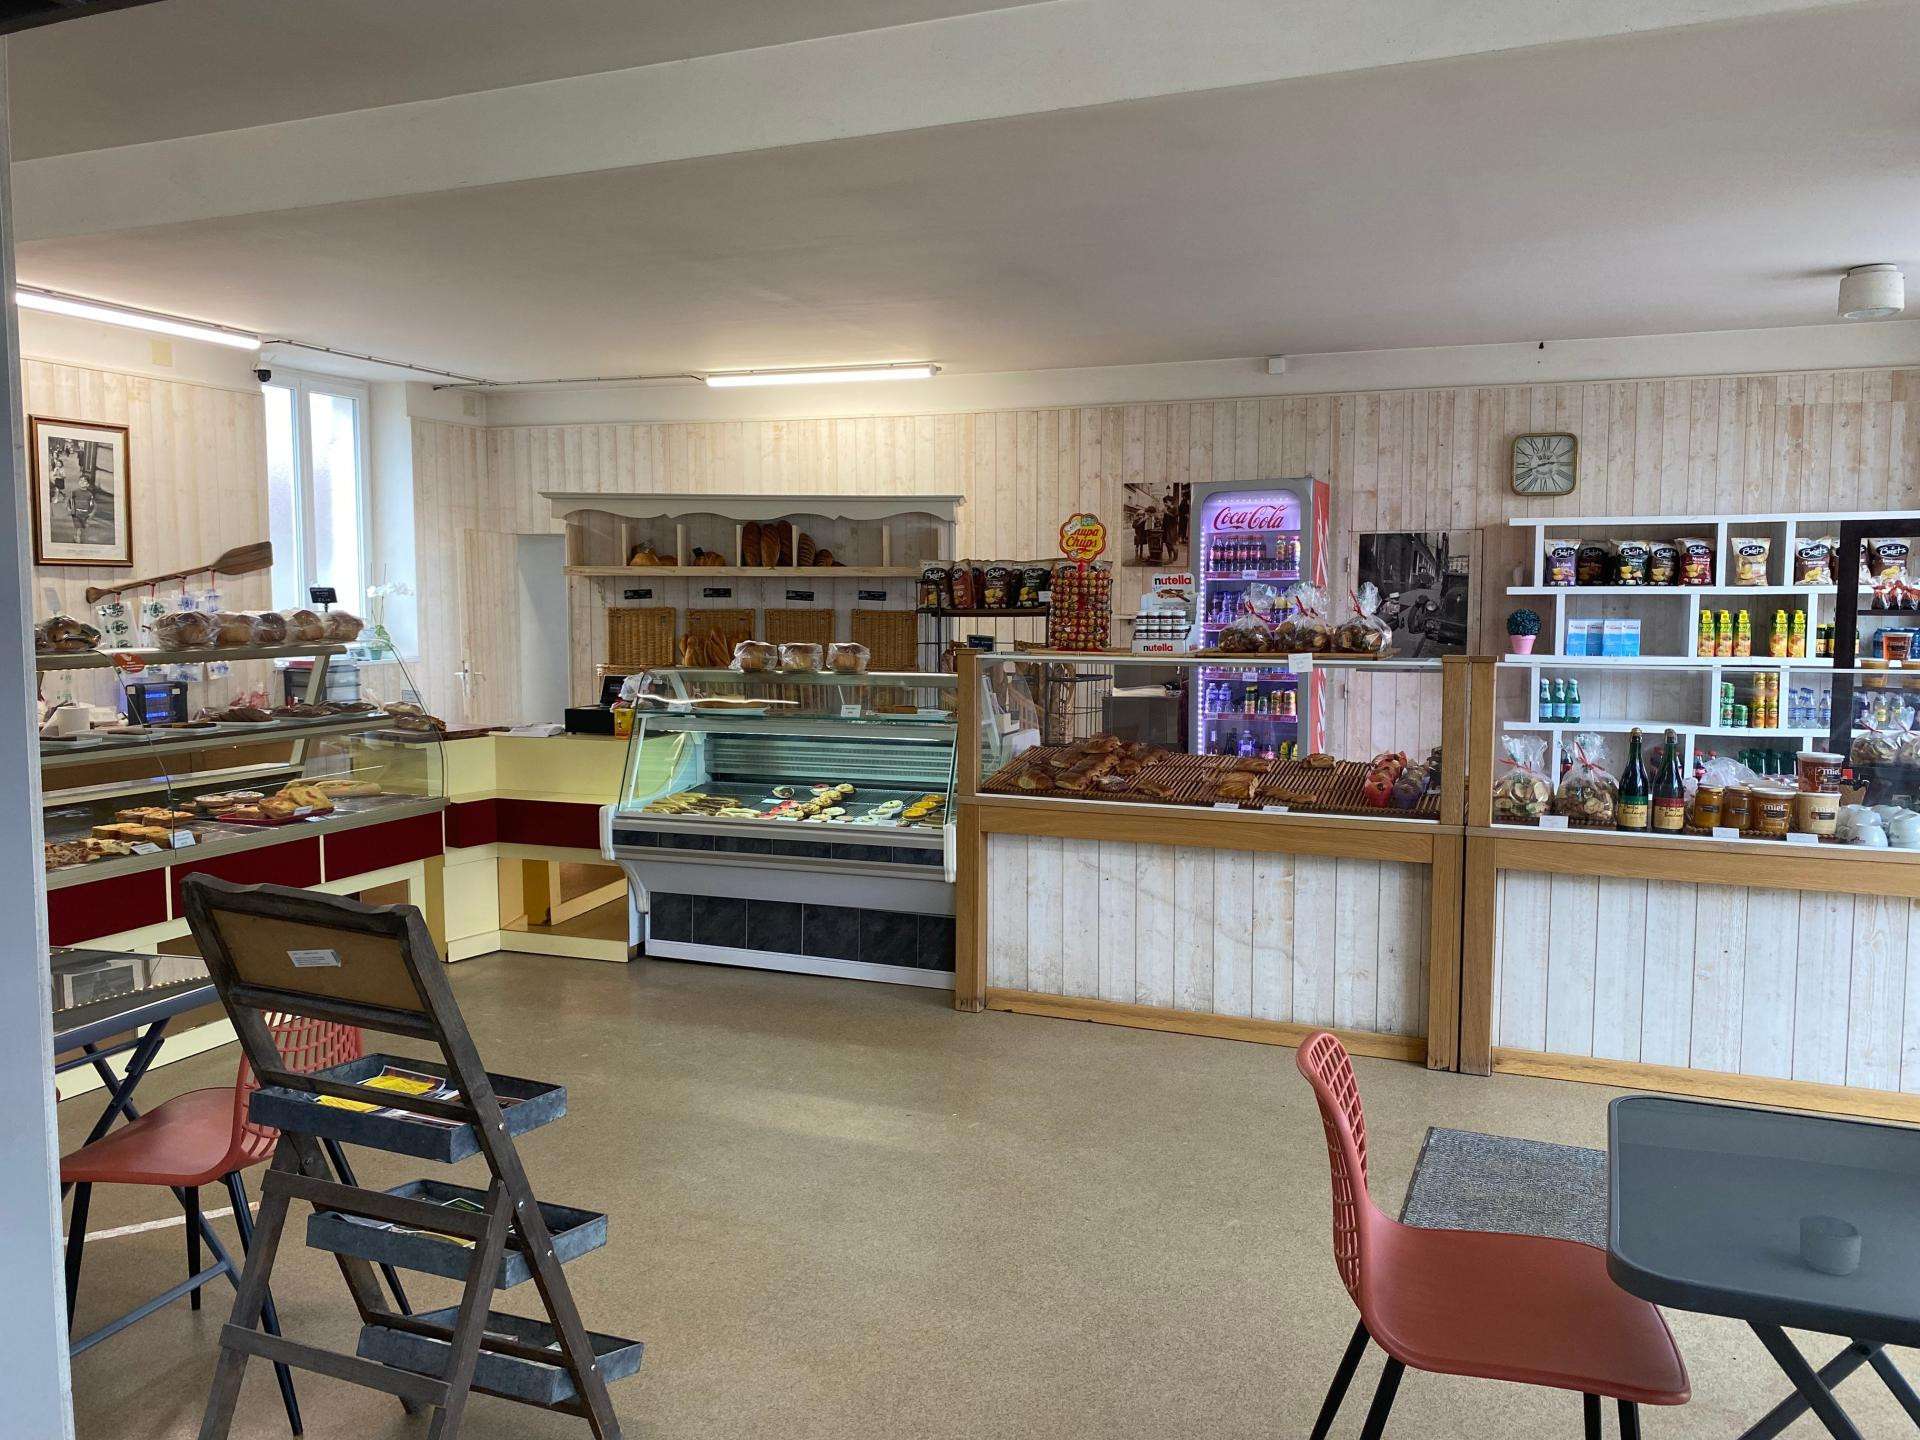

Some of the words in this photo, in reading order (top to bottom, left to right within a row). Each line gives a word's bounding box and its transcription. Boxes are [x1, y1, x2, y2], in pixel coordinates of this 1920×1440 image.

[1213, 504, 1288, 530] Coca-Cola
[1066, 536, 1097, 549] Chups
[1154, 575, 1192, 585] nutella
[1143, 643, 1173, 652] nutella
